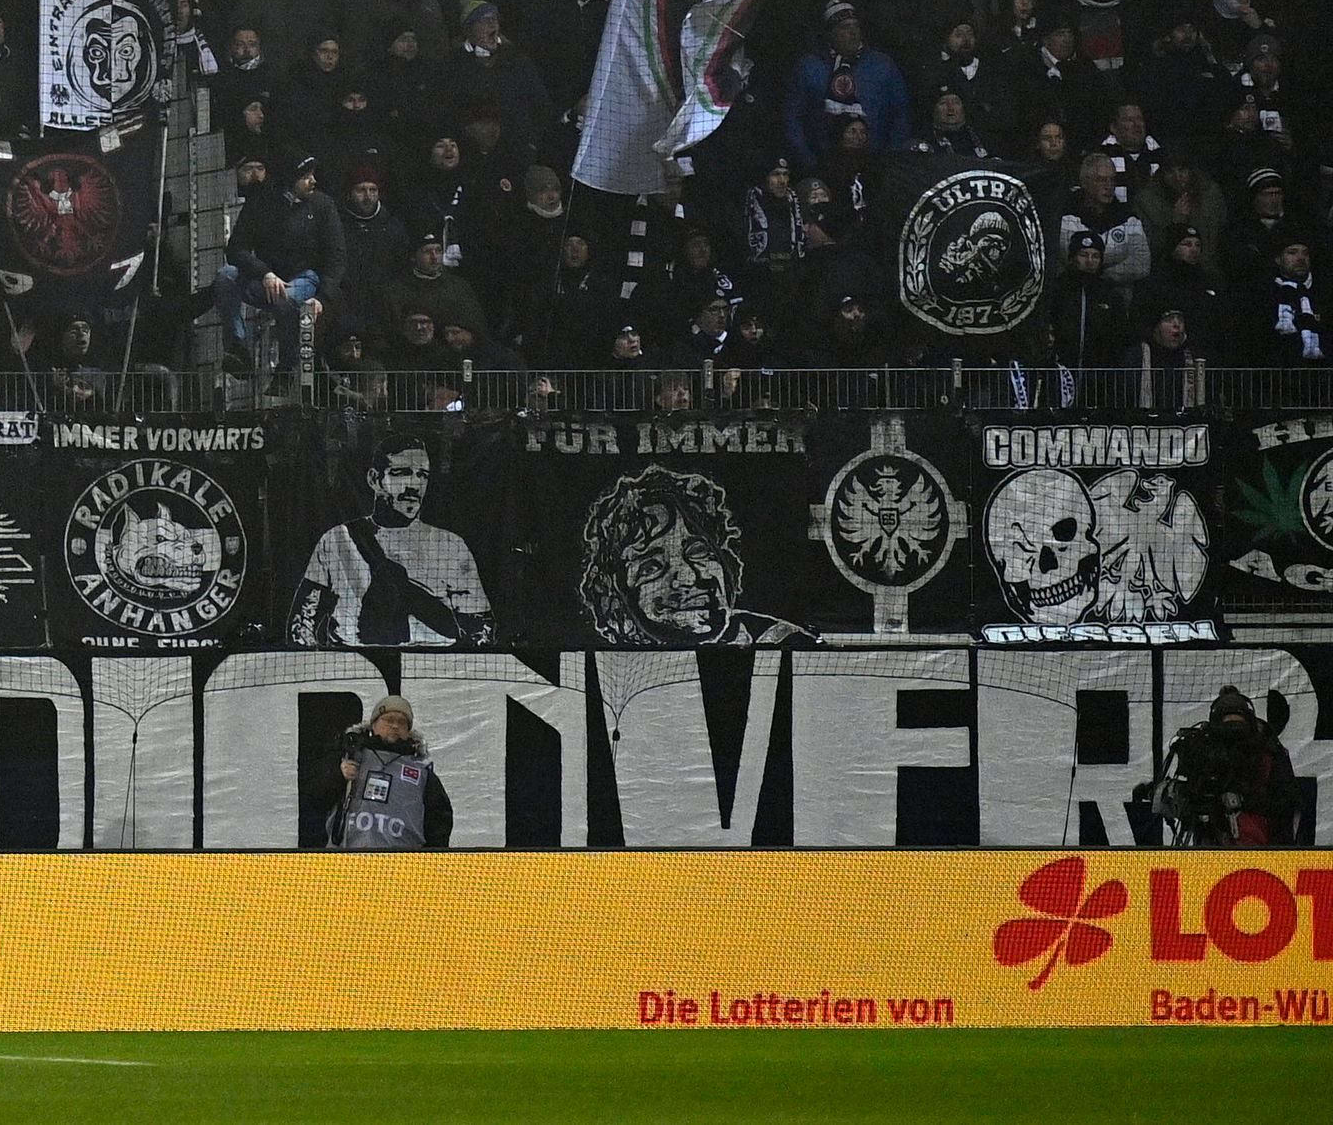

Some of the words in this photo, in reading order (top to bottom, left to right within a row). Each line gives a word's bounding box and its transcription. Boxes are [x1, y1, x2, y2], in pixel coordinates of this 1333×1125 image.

[932, 180, 1028, 214] ULTRAS
[53, 424, 139, 451] IMMER
[636, 421, 805, 454] IMMER
[983, 426, 1210, 467] COMMANDO
[74, 463, 233, 532] RADIKALE
[348, 811, 405, 838] FOTO
[639, 995, 701, 1026] Die
[710, 994, 878, 1026] Lotterien
[888, 1002, 953, 1026] von
